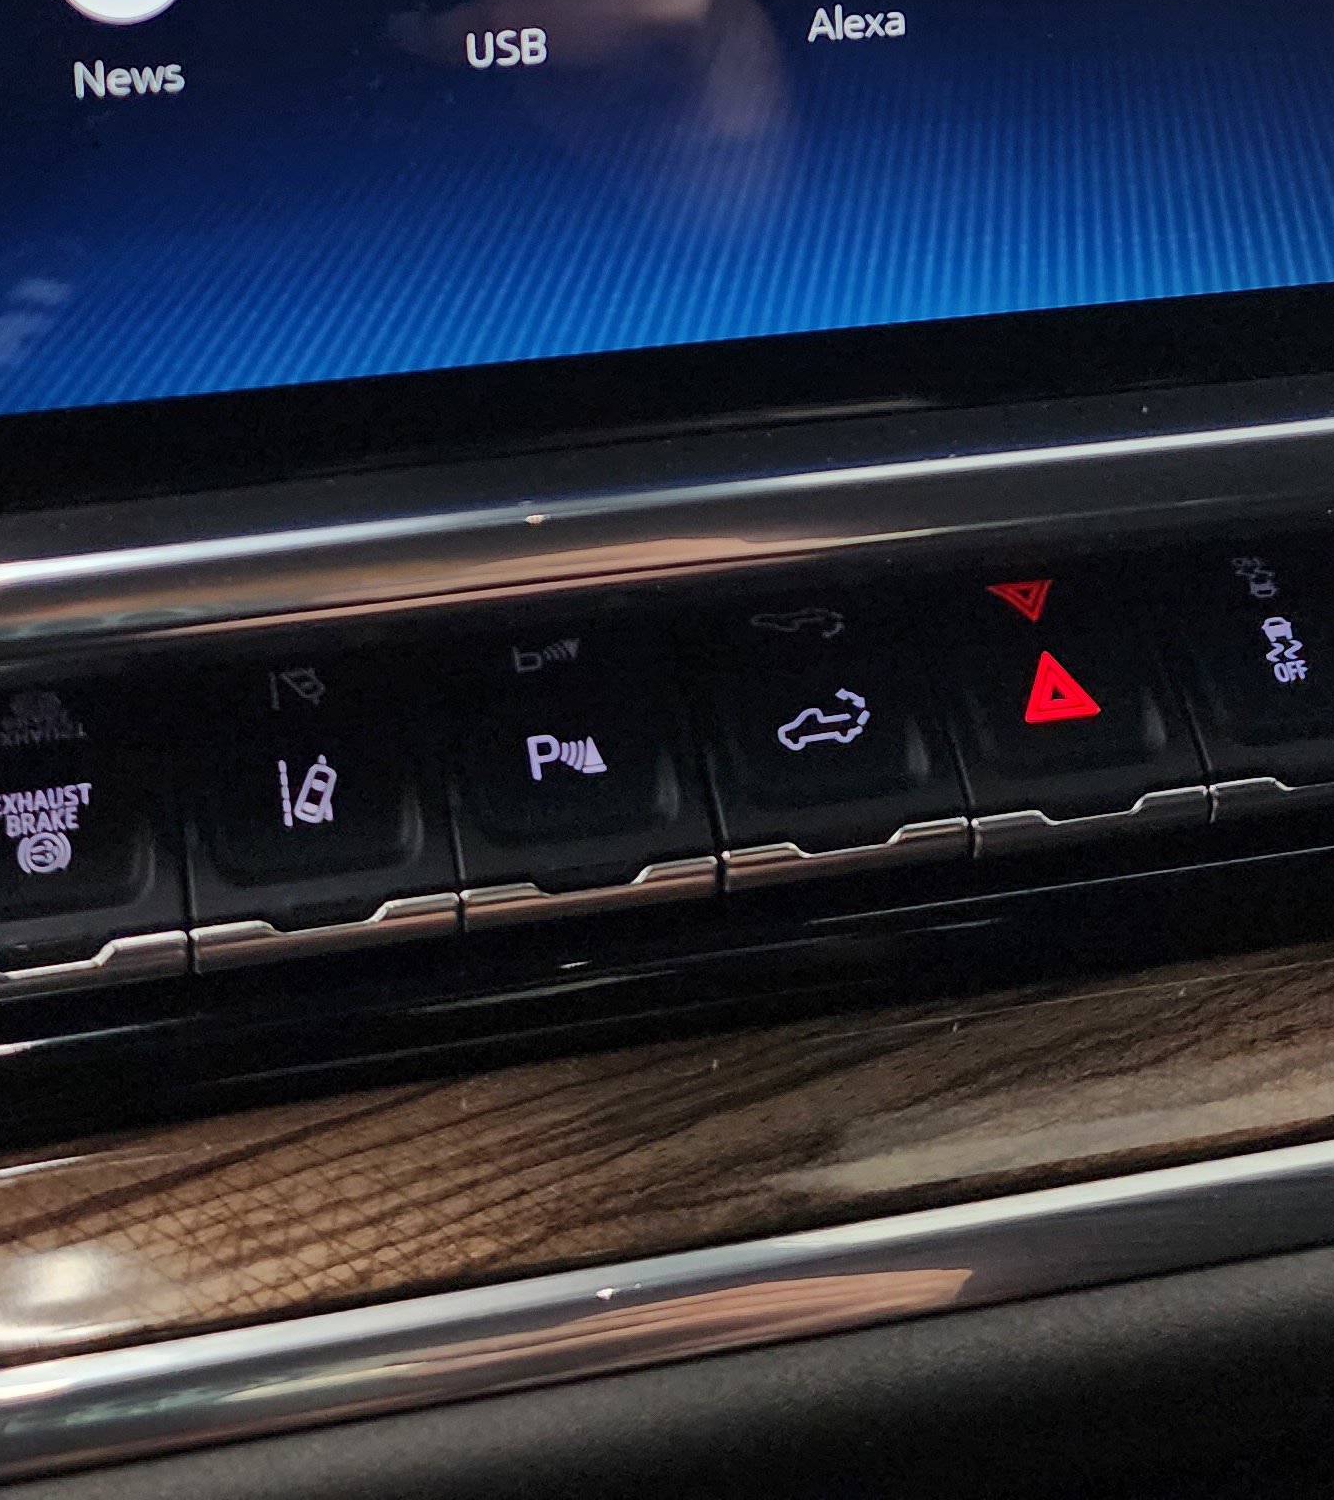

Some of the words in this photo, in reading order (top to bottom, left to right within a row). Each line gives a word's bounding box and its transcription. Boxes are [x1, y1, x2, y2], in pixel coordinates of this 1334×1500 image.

[808, 4, 905, 42] Alexa
[467, 28, 546, 68] USB
[74, 60, 185, 98] News
[1274, 659, 1308, 683] OFF
[5, 806, 80, 838] BRAKE
